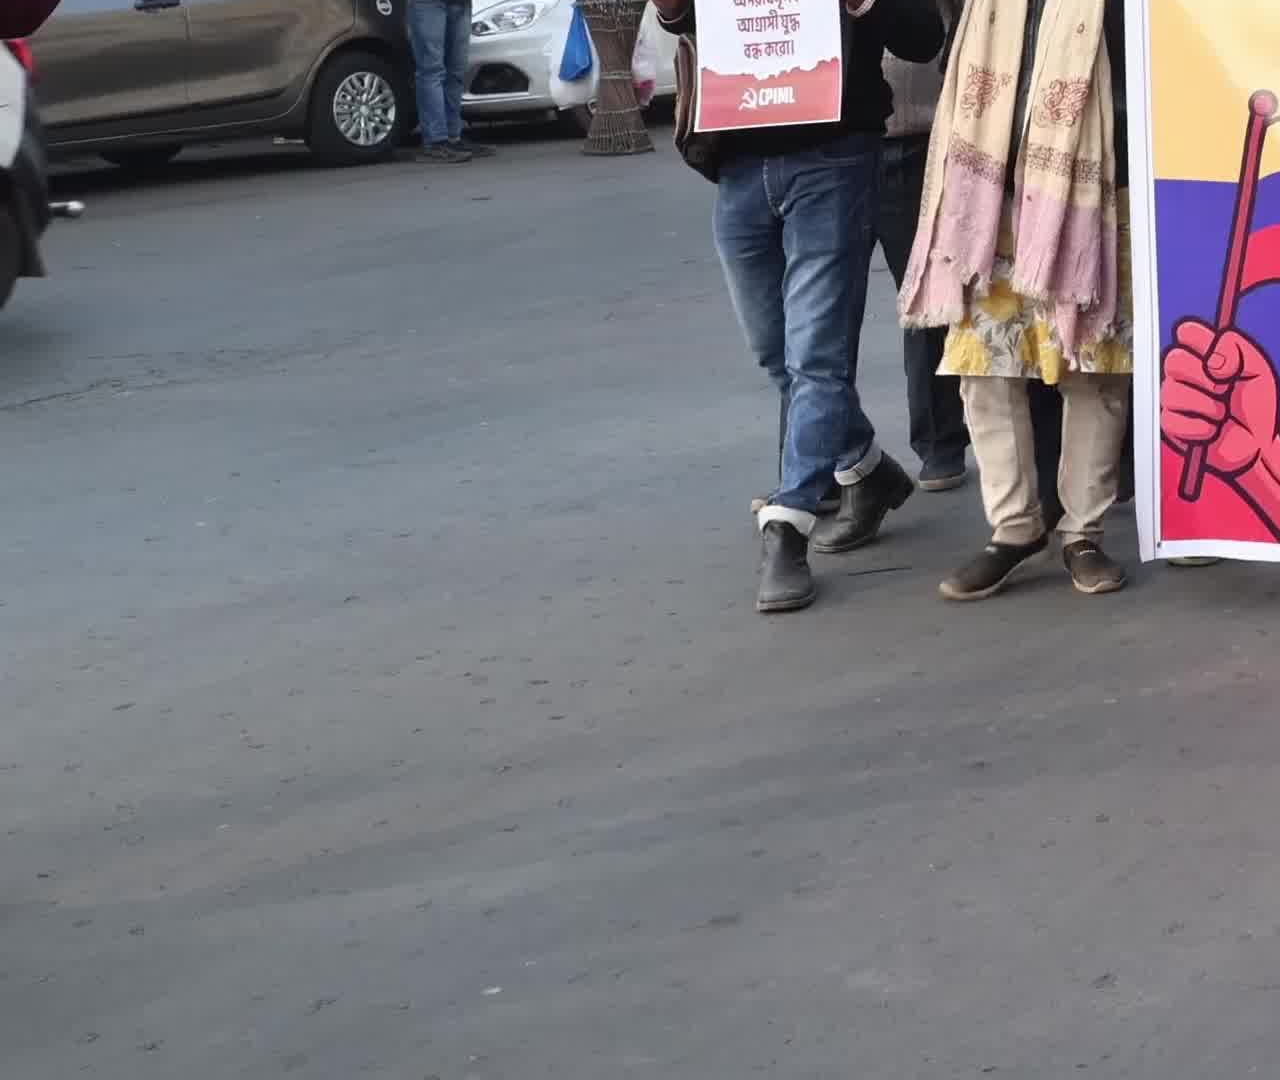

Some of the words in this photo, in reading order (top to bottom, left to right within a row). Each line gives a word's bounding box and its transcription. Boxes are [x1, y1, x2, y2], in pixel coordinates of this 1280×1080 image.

[736, 8, 779, 33] আগ্রাসী
[780, 12, 801, 36] যুদ্ধ
[758, 86, 796, 106] CPIML
